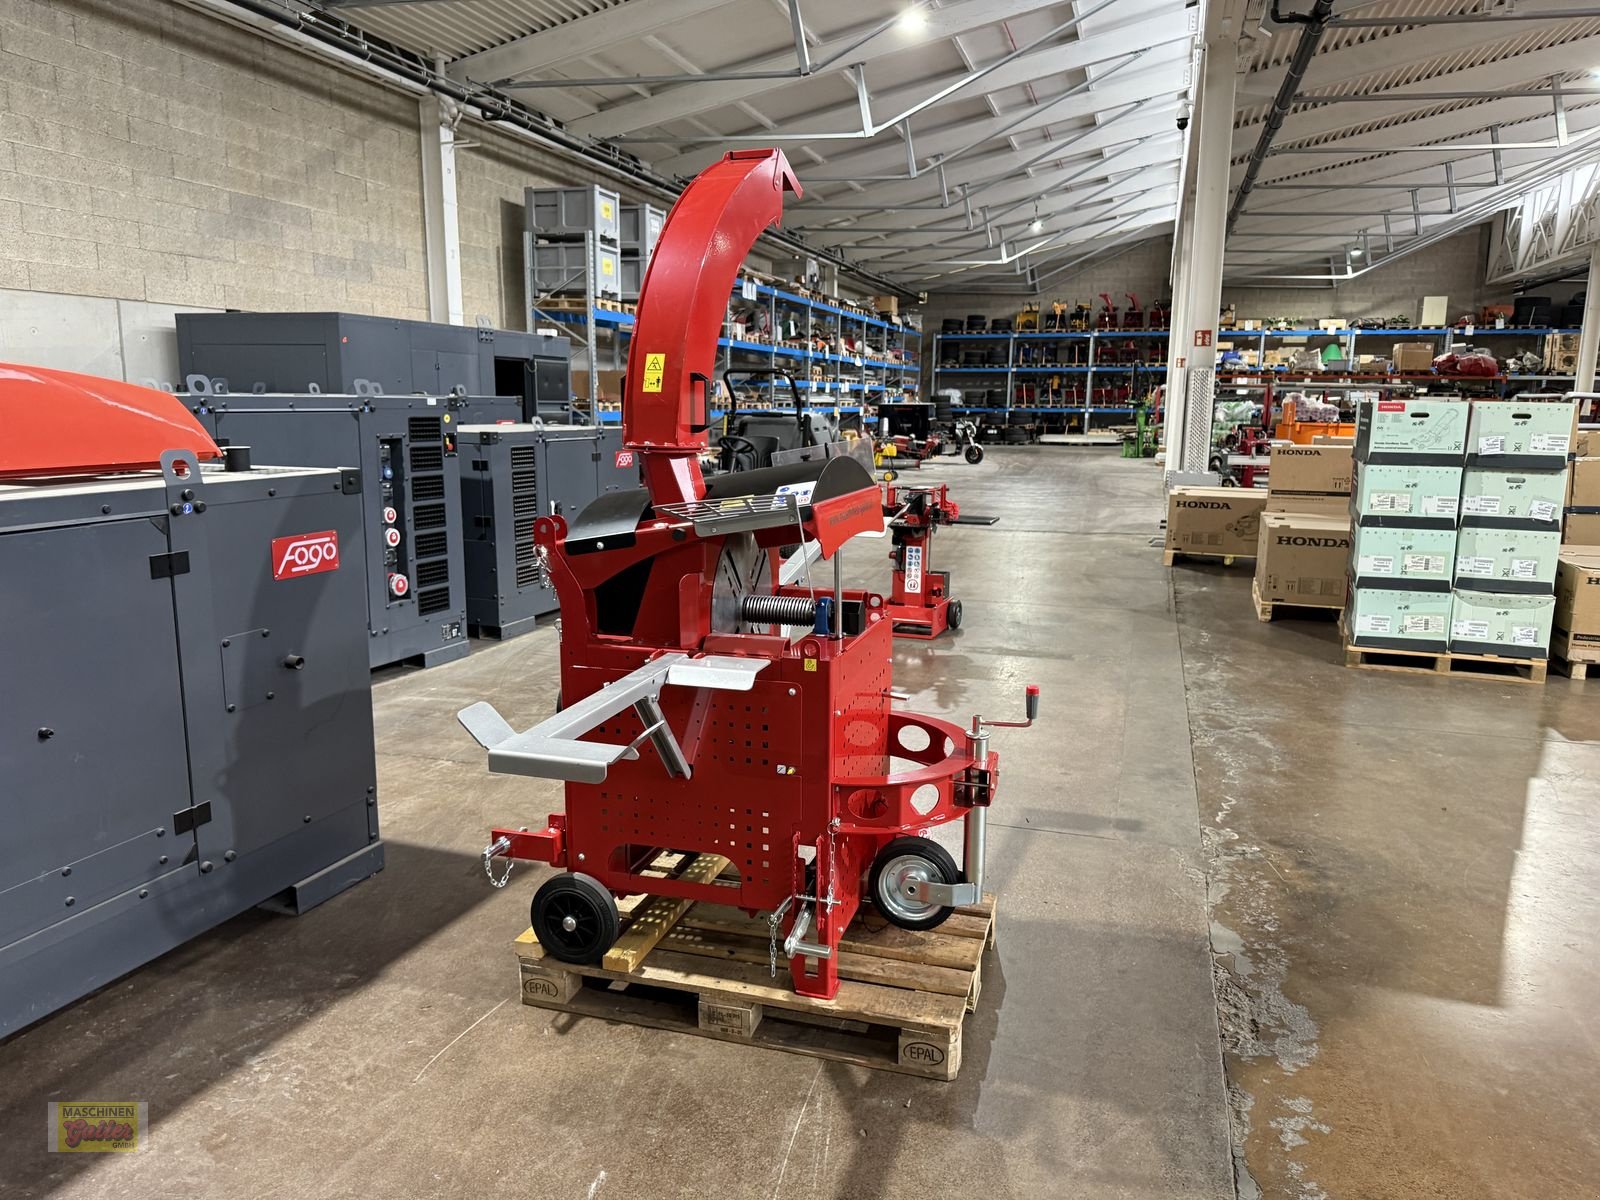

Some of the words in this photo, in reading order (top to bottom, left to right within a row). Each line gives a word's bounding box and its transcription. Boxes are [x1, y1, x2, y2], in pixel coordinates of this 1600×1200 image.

[1277, 449, 1322, 457] HONDA
[1175, 500, 1232, 510] HONDA
[1276, 535, 1349, 548] HONDA
[529, 981, 553, 996] EPAL
[909, 1046, 938, 1062] EPAL
